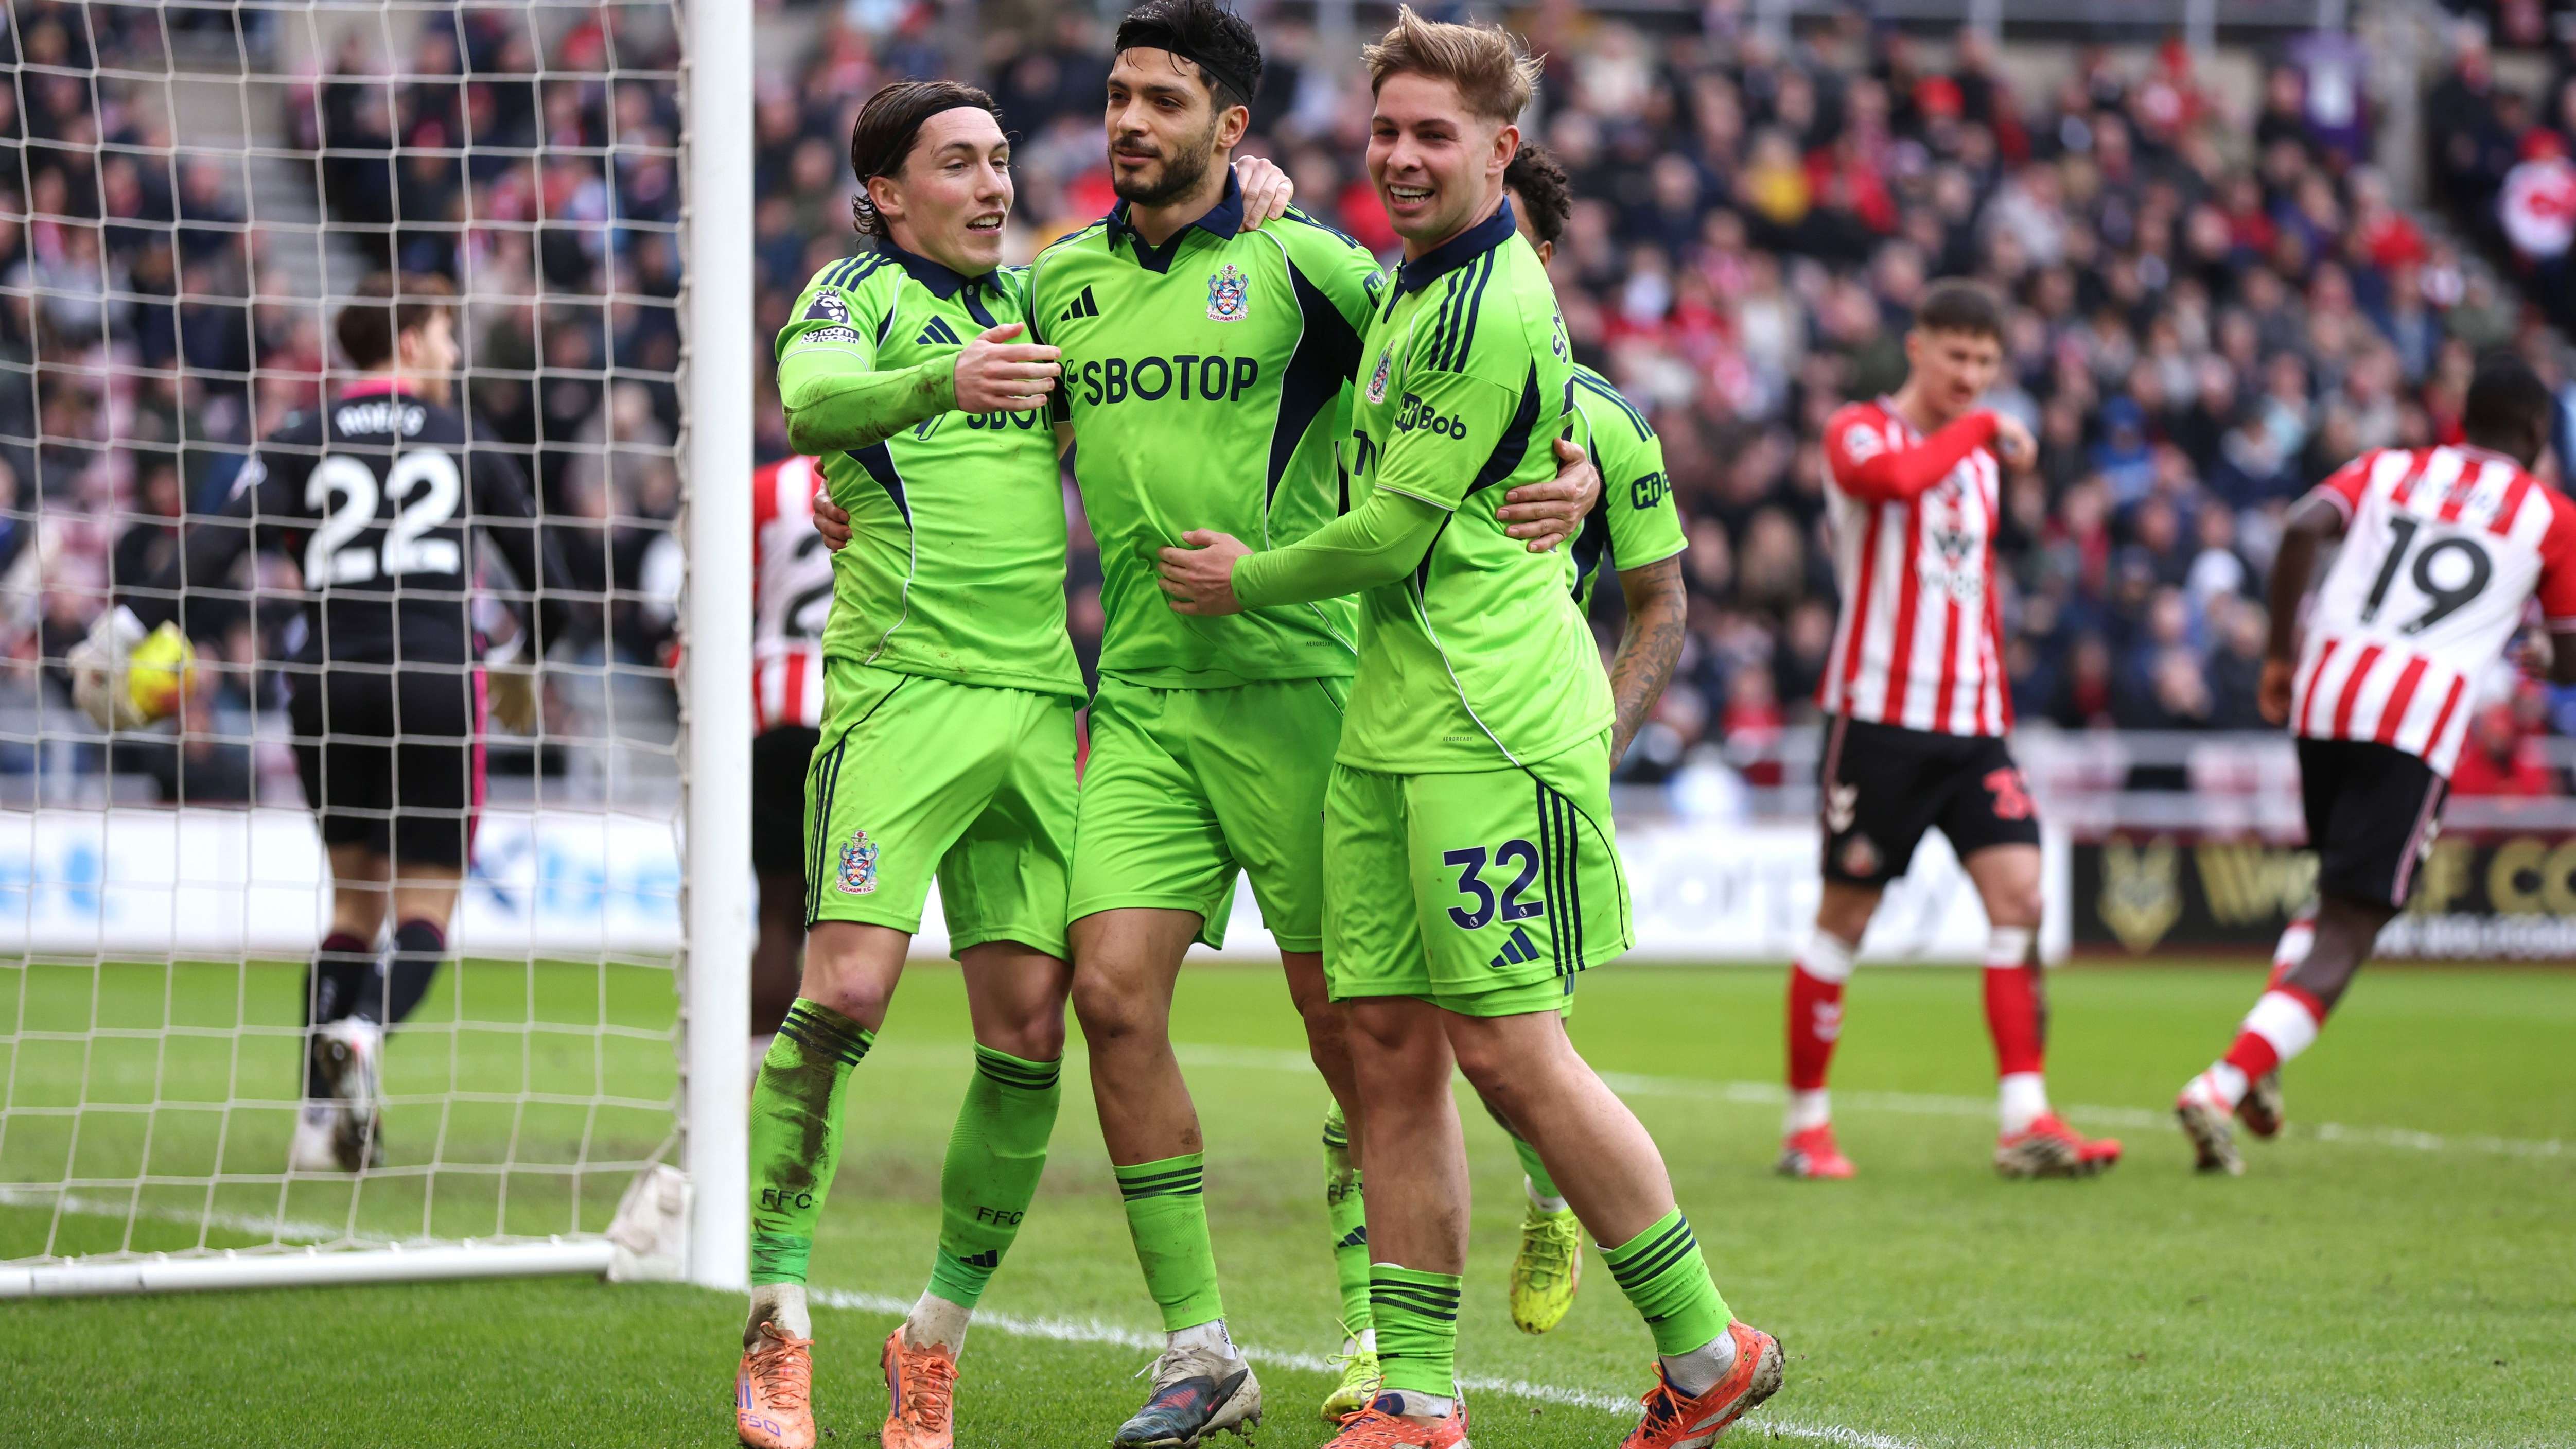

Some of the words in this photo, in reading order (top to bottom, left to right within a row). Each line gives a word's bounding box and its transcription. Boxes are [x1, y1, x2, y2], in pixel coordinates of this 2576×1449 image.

[817, 335, 859, 344] racism
[819, 327, 854, 338] room
[1083, 355, 1259, 406] SBOTOP
[305, 447, 461, 590] 22
[2361, 516, 2493, 634] 19
[838, 885, 862, 893] FULHAM
[1443, 839, 1544, 930] 32
[762, 1188, 812, 1209] FFC
[976, 1206, 1024, 1225] FFC
